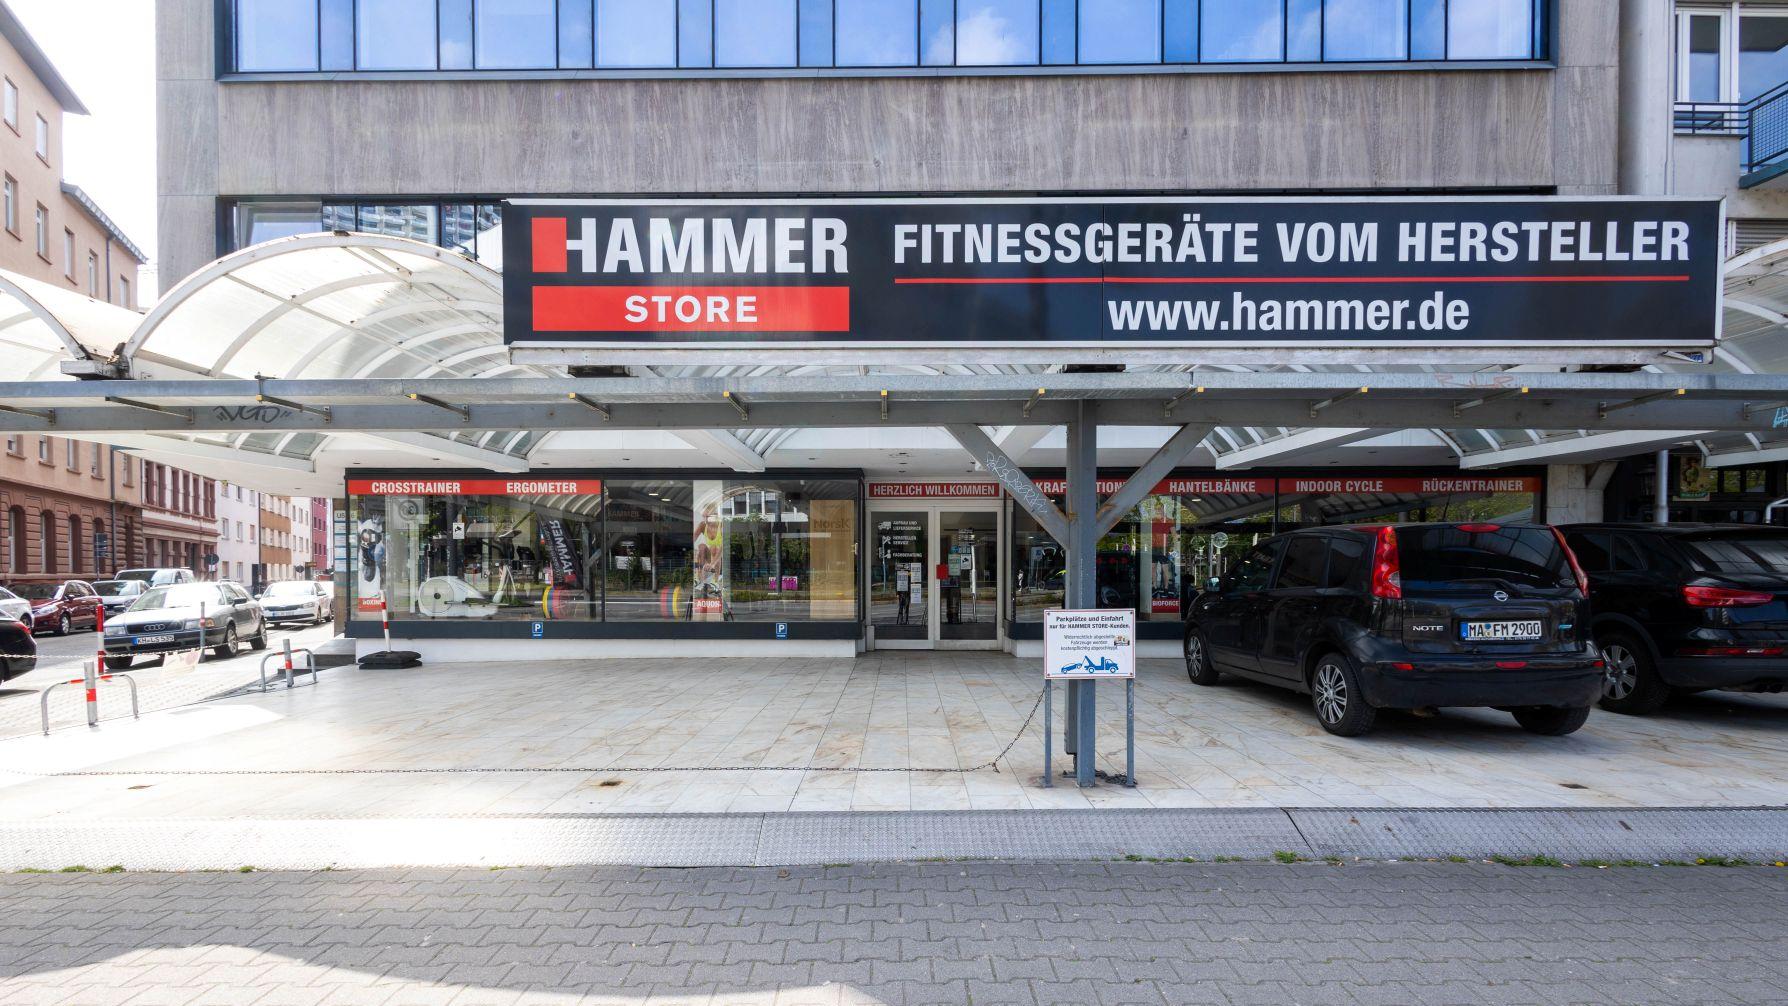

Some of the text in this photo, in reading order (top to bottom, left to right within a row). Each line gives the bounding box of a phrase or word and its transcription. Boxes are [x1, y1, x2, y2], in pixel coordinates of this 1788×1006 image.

[532, 217, 849, 274] HAMMER
[894, 213, 1690, 264] FITNESSGERÄTE VOM HERSTELLER
[624, 295, 758, 324] STORE
[1110, 291, 1470, 331] www.hammer.de
[371, 482, 577, 493] CROSSTRAINER ERGOMETER
[873, 484, 995, 496] HERZLICH WILLKOMMEN
[1169, 479, 1256, 493] HANTELBÄNKE
[1296, 480, 1383, 492] INDOOR CYCLE
[1422, 478, 1523, 492] RÜCKENTRAINER
[1468, 622, 1540, 637] MA FM 2900
